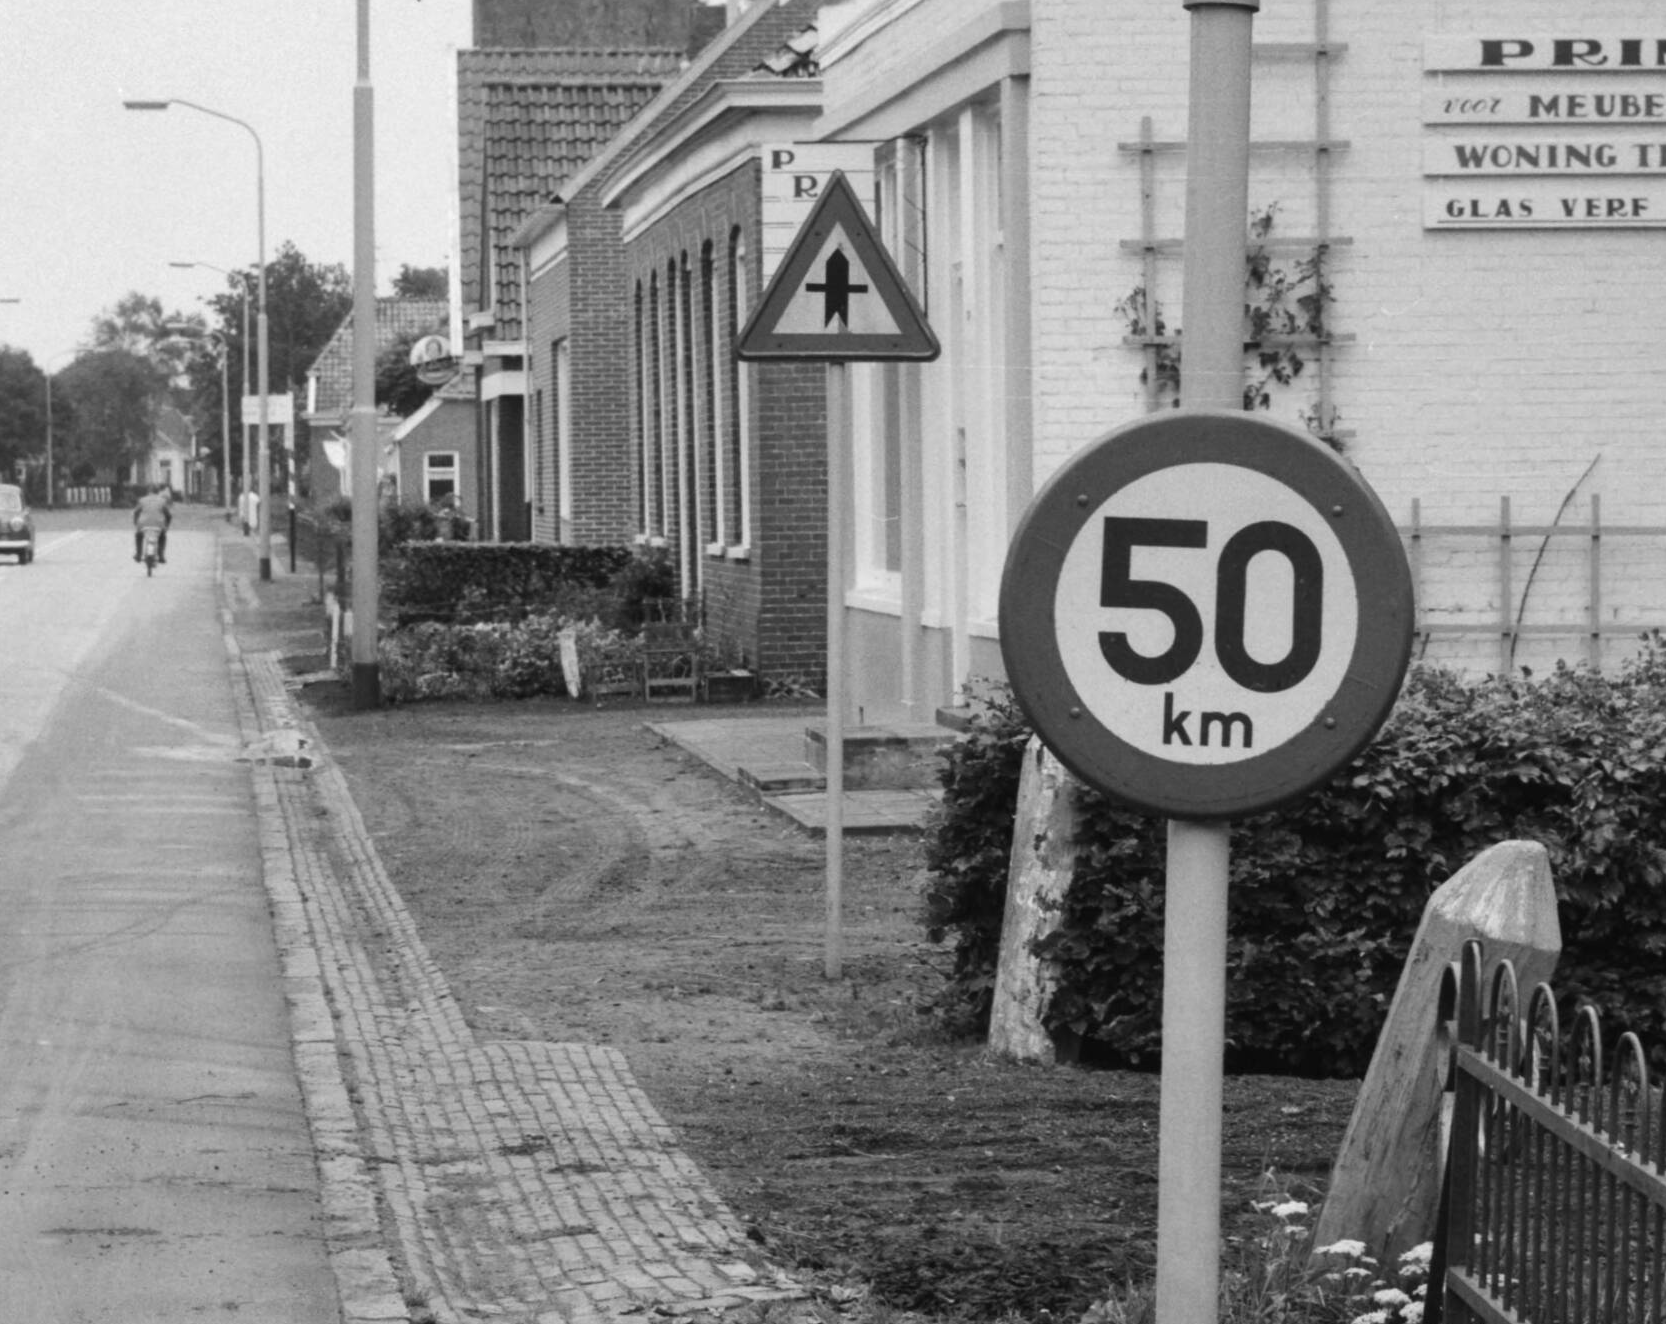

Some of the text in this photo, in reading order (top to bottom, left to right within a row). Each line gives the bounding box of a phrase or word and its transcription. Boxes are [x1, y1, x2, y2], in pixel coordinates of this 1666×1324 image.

[1443, 98, 1503, 115] voor
[1454, 144, 1619, 169] WONING
[1446, 198, 1534, 218] GLAS
[1560, 197, 1650, 218] VERF
[1098, 516, 1324, 694] 50
[1162, 691, 1254, 749] km
